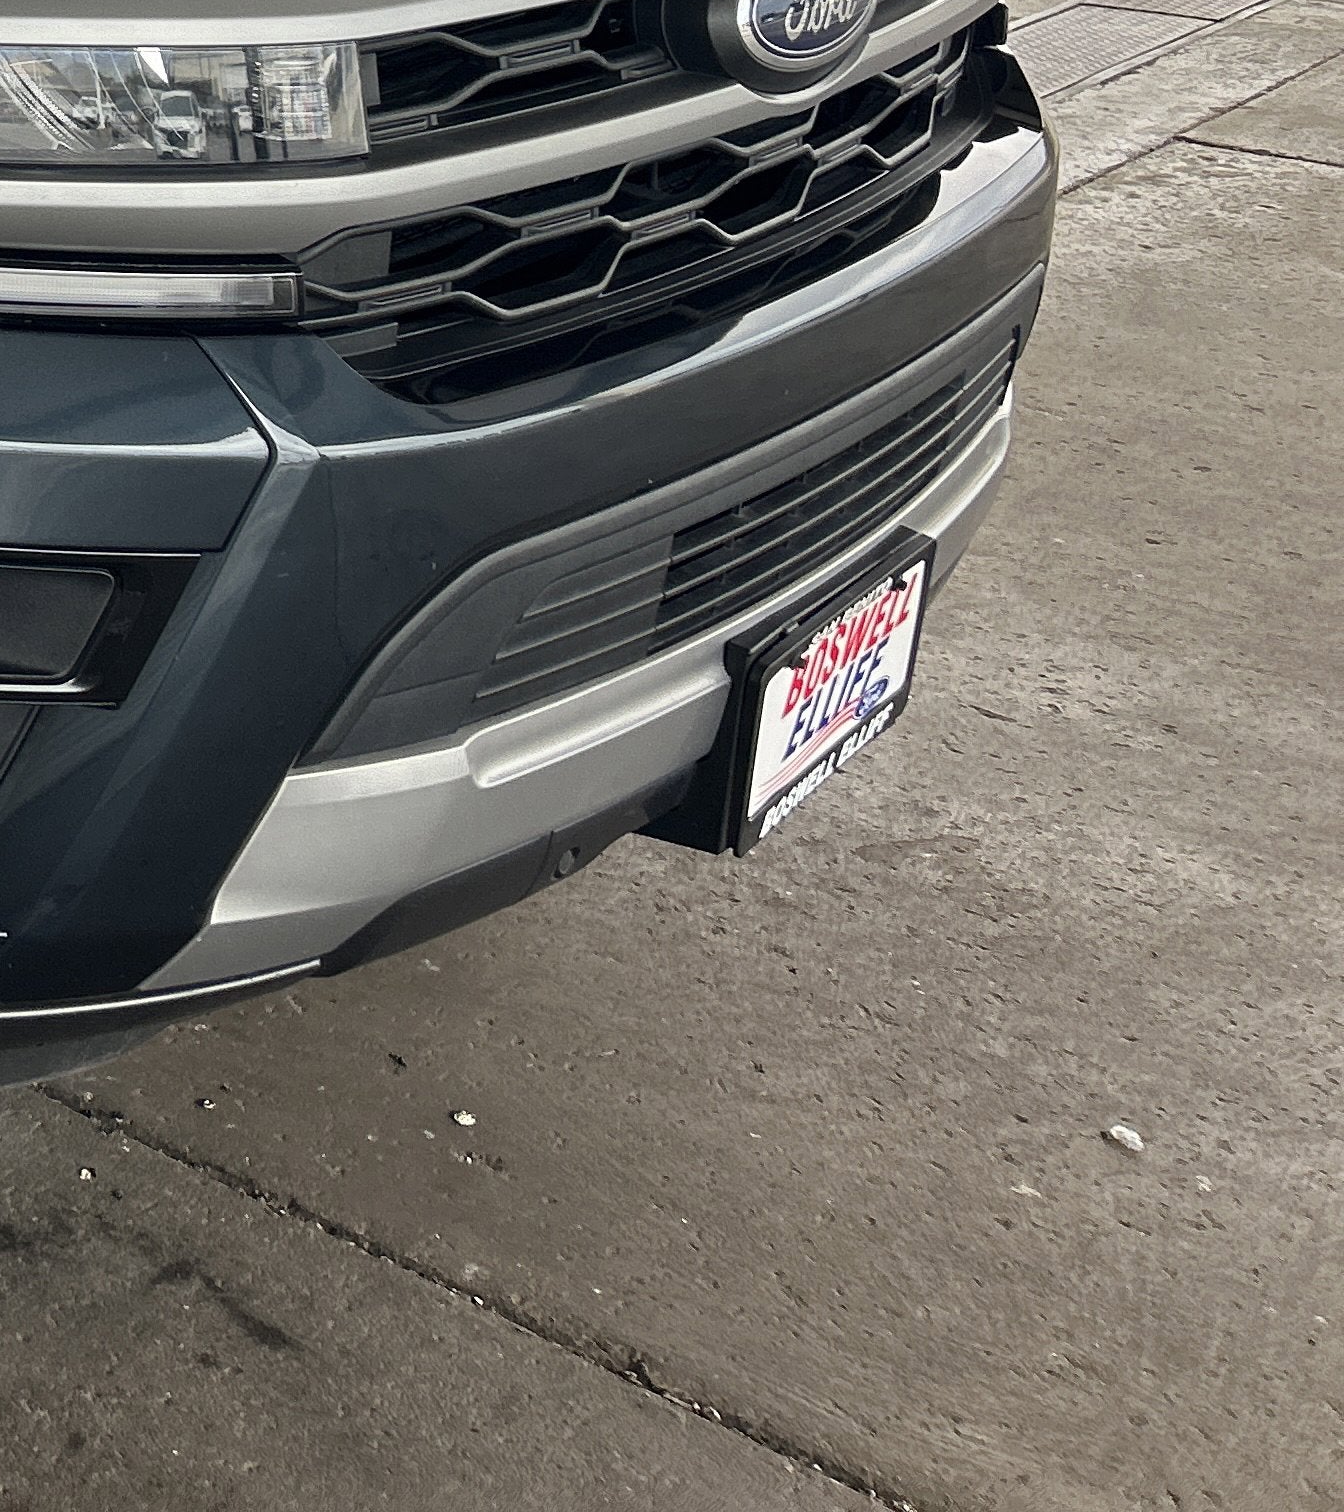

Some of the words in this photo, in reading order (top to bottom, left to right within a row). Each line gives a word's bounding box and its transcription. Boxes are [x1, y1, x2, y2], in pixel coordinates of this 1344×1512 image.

[780, 573, 918, 720] BOSWELL
[780, 636, 891, 764] ELLIFF
[759, 751, 837, 839] BOSWELL
[836, 701, 895, 768] ELLIFF
